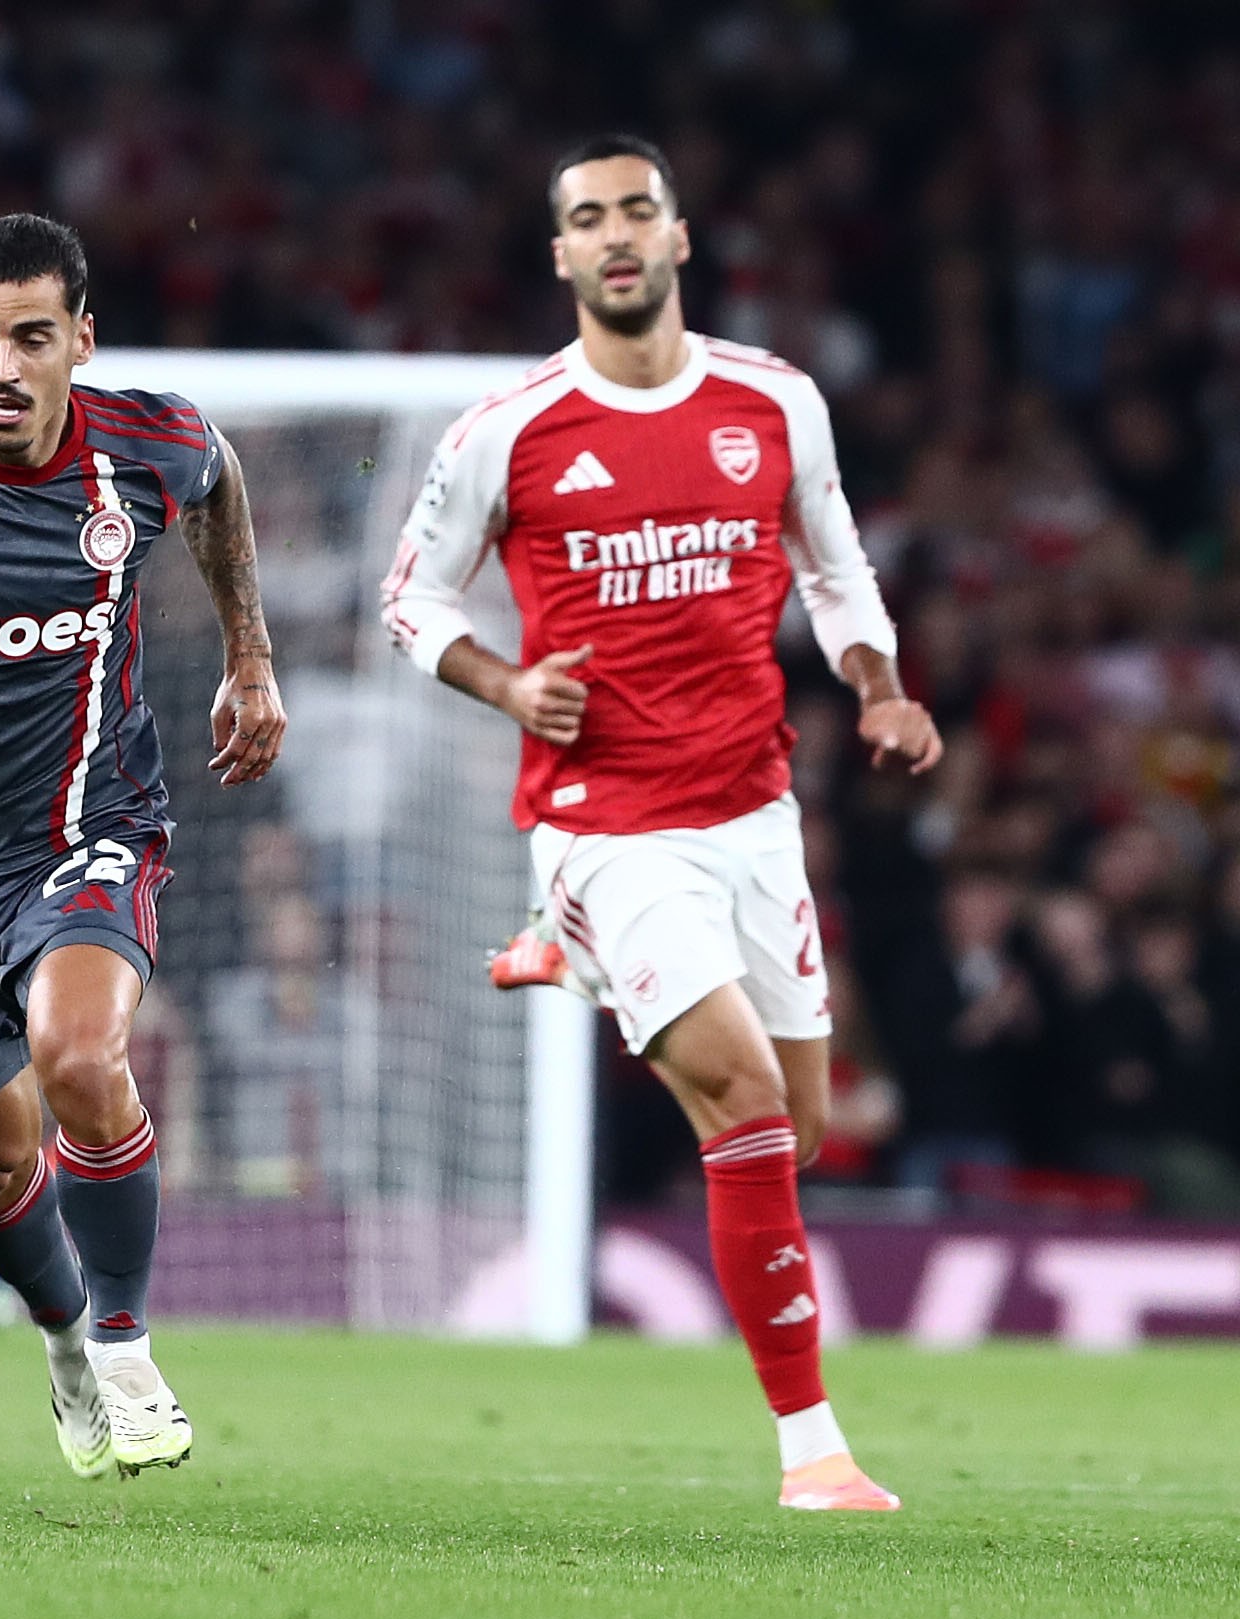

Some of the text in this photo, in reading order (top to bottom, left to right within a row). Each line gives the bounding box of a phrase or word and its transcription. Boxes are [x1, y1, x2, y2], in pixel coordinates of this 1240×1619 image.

[564, 517, 758, 571] Emirates
[598, 556, 732, 607] FLY BETTER
[42, 838, 136, 899] 22
